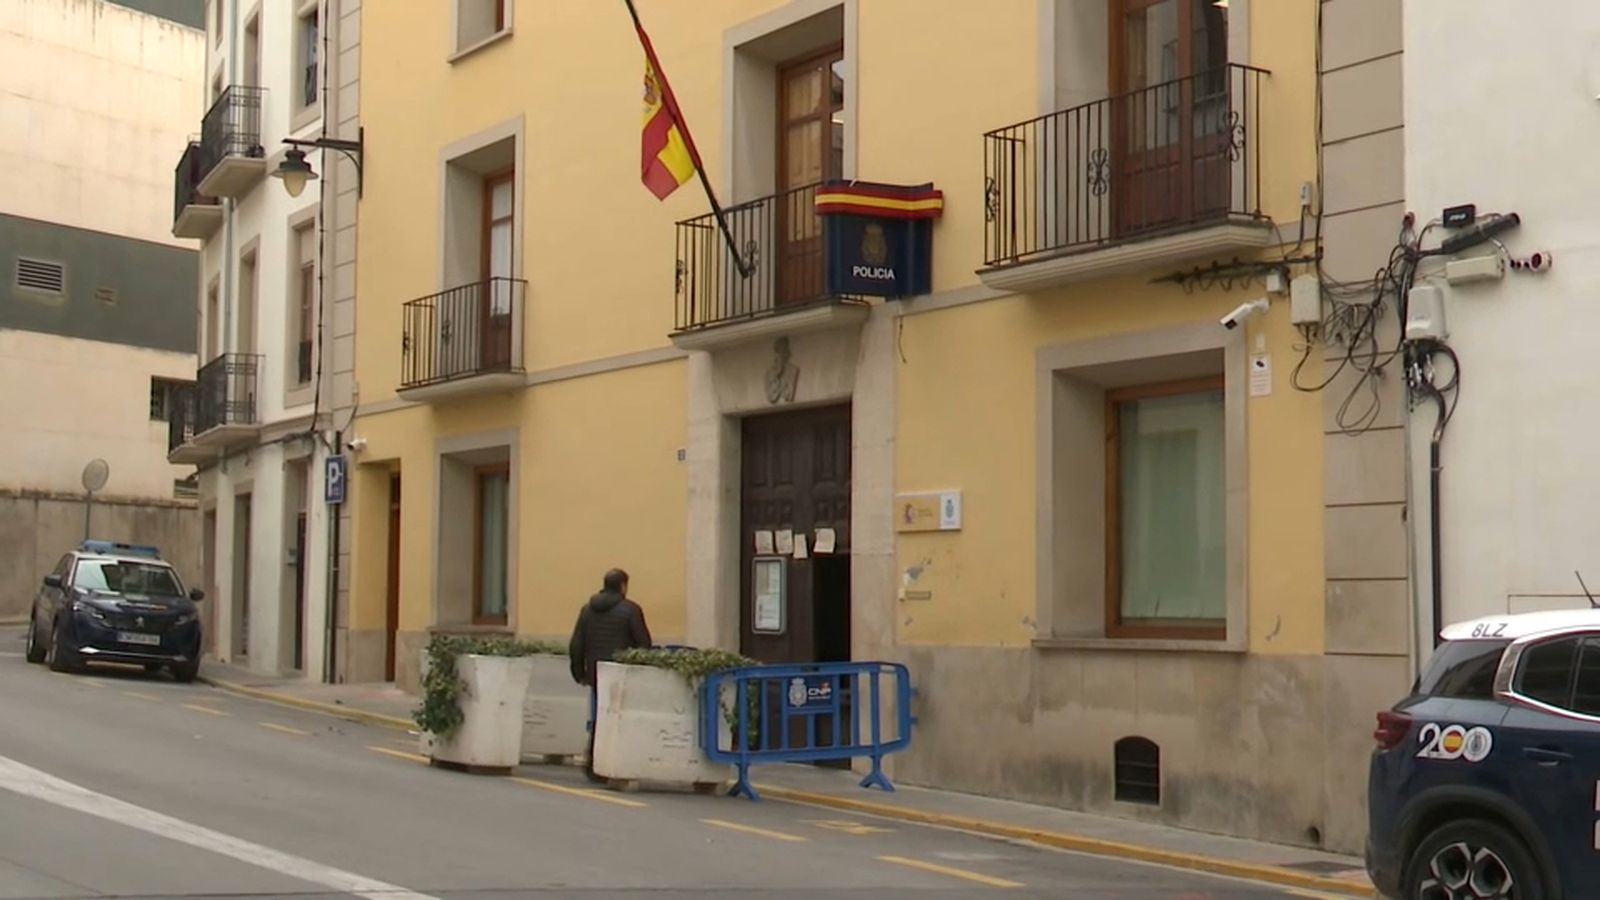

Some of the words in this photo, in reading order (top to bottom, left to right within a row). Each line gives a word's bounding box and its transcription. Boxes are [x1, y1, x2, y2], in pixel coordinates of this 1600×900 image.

[852, 265, 896, 280] POLICIA
[327, 461, 340, 497] P
[1471, 623, 1508, 638] 8LZ
[1415, 722, 1493, 762] 200
